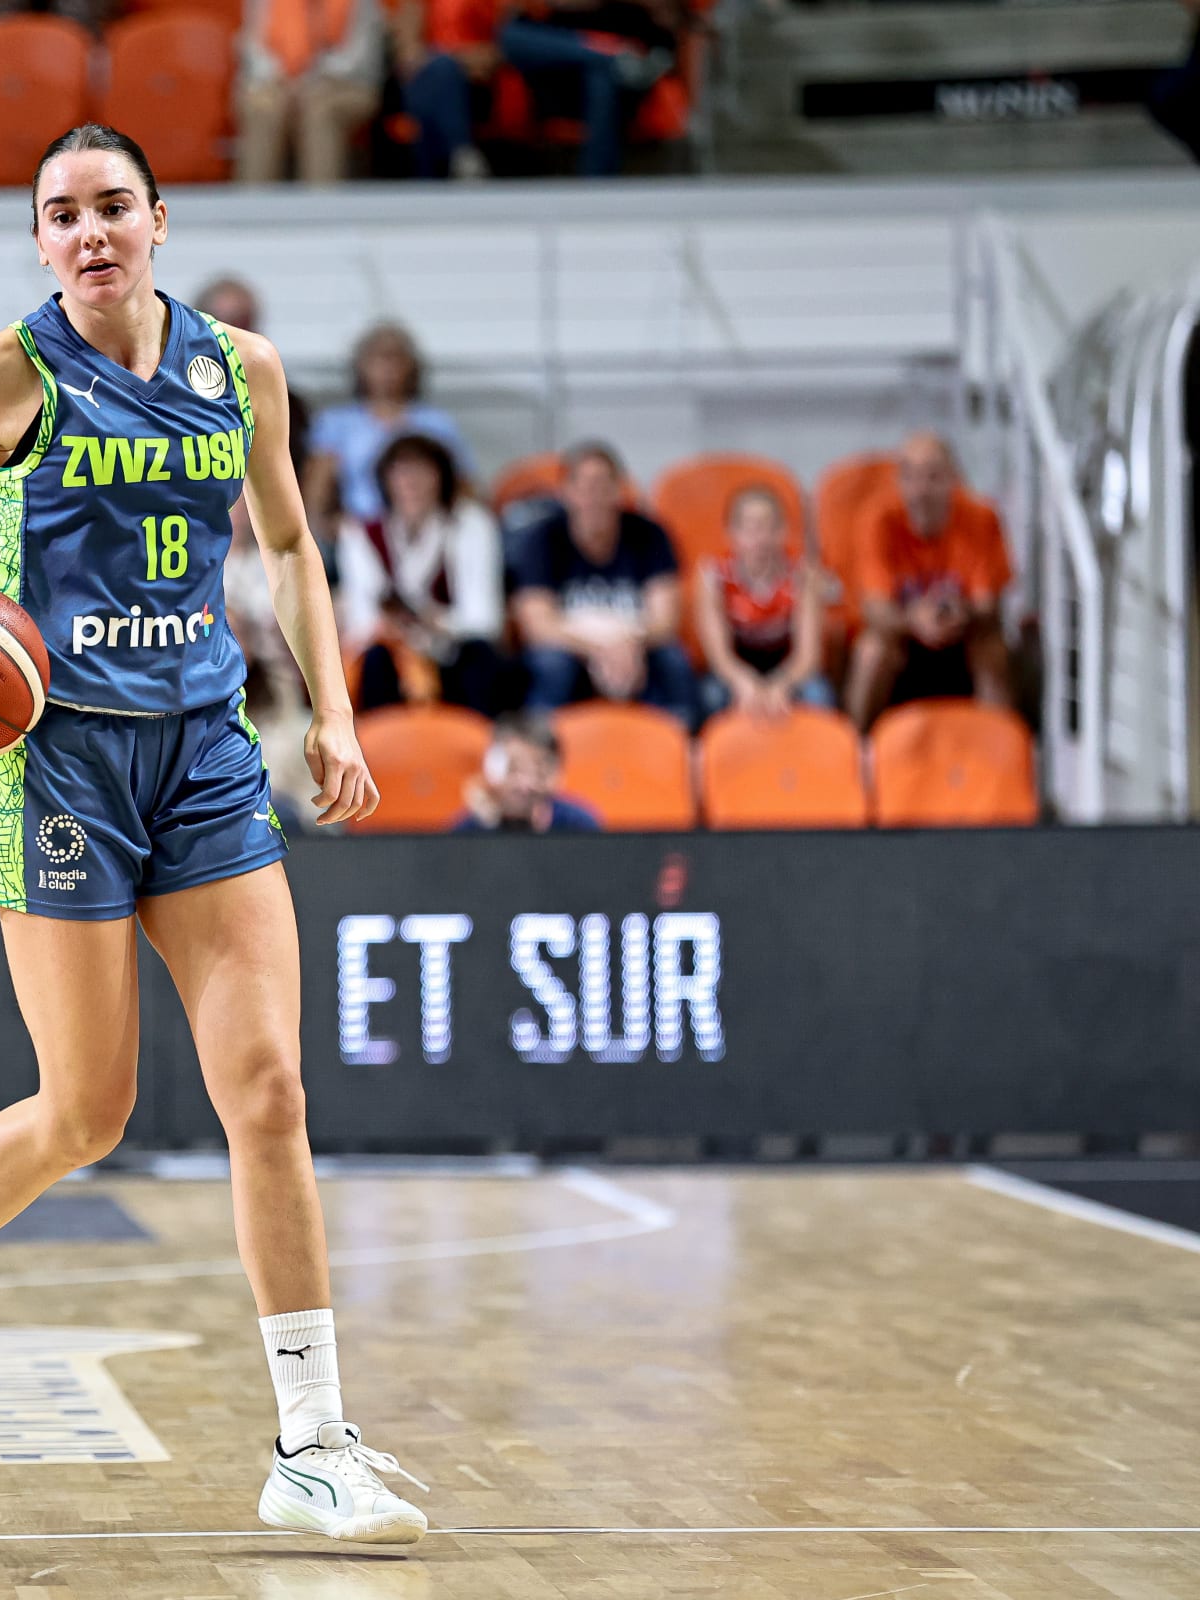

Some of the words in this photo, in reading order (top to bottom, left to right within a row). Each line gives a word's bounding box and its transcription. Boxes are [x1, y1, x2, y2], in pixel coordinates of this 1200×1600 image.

[61, 435, 171, 488] ZVVZ
[141, 515, 189, 581] 18
[47, 868, 87, 881] media
[47, 879, 77, 891] club
[337, 914, 474, 1065] ET
[509, 912, 726, 1064] SUR
